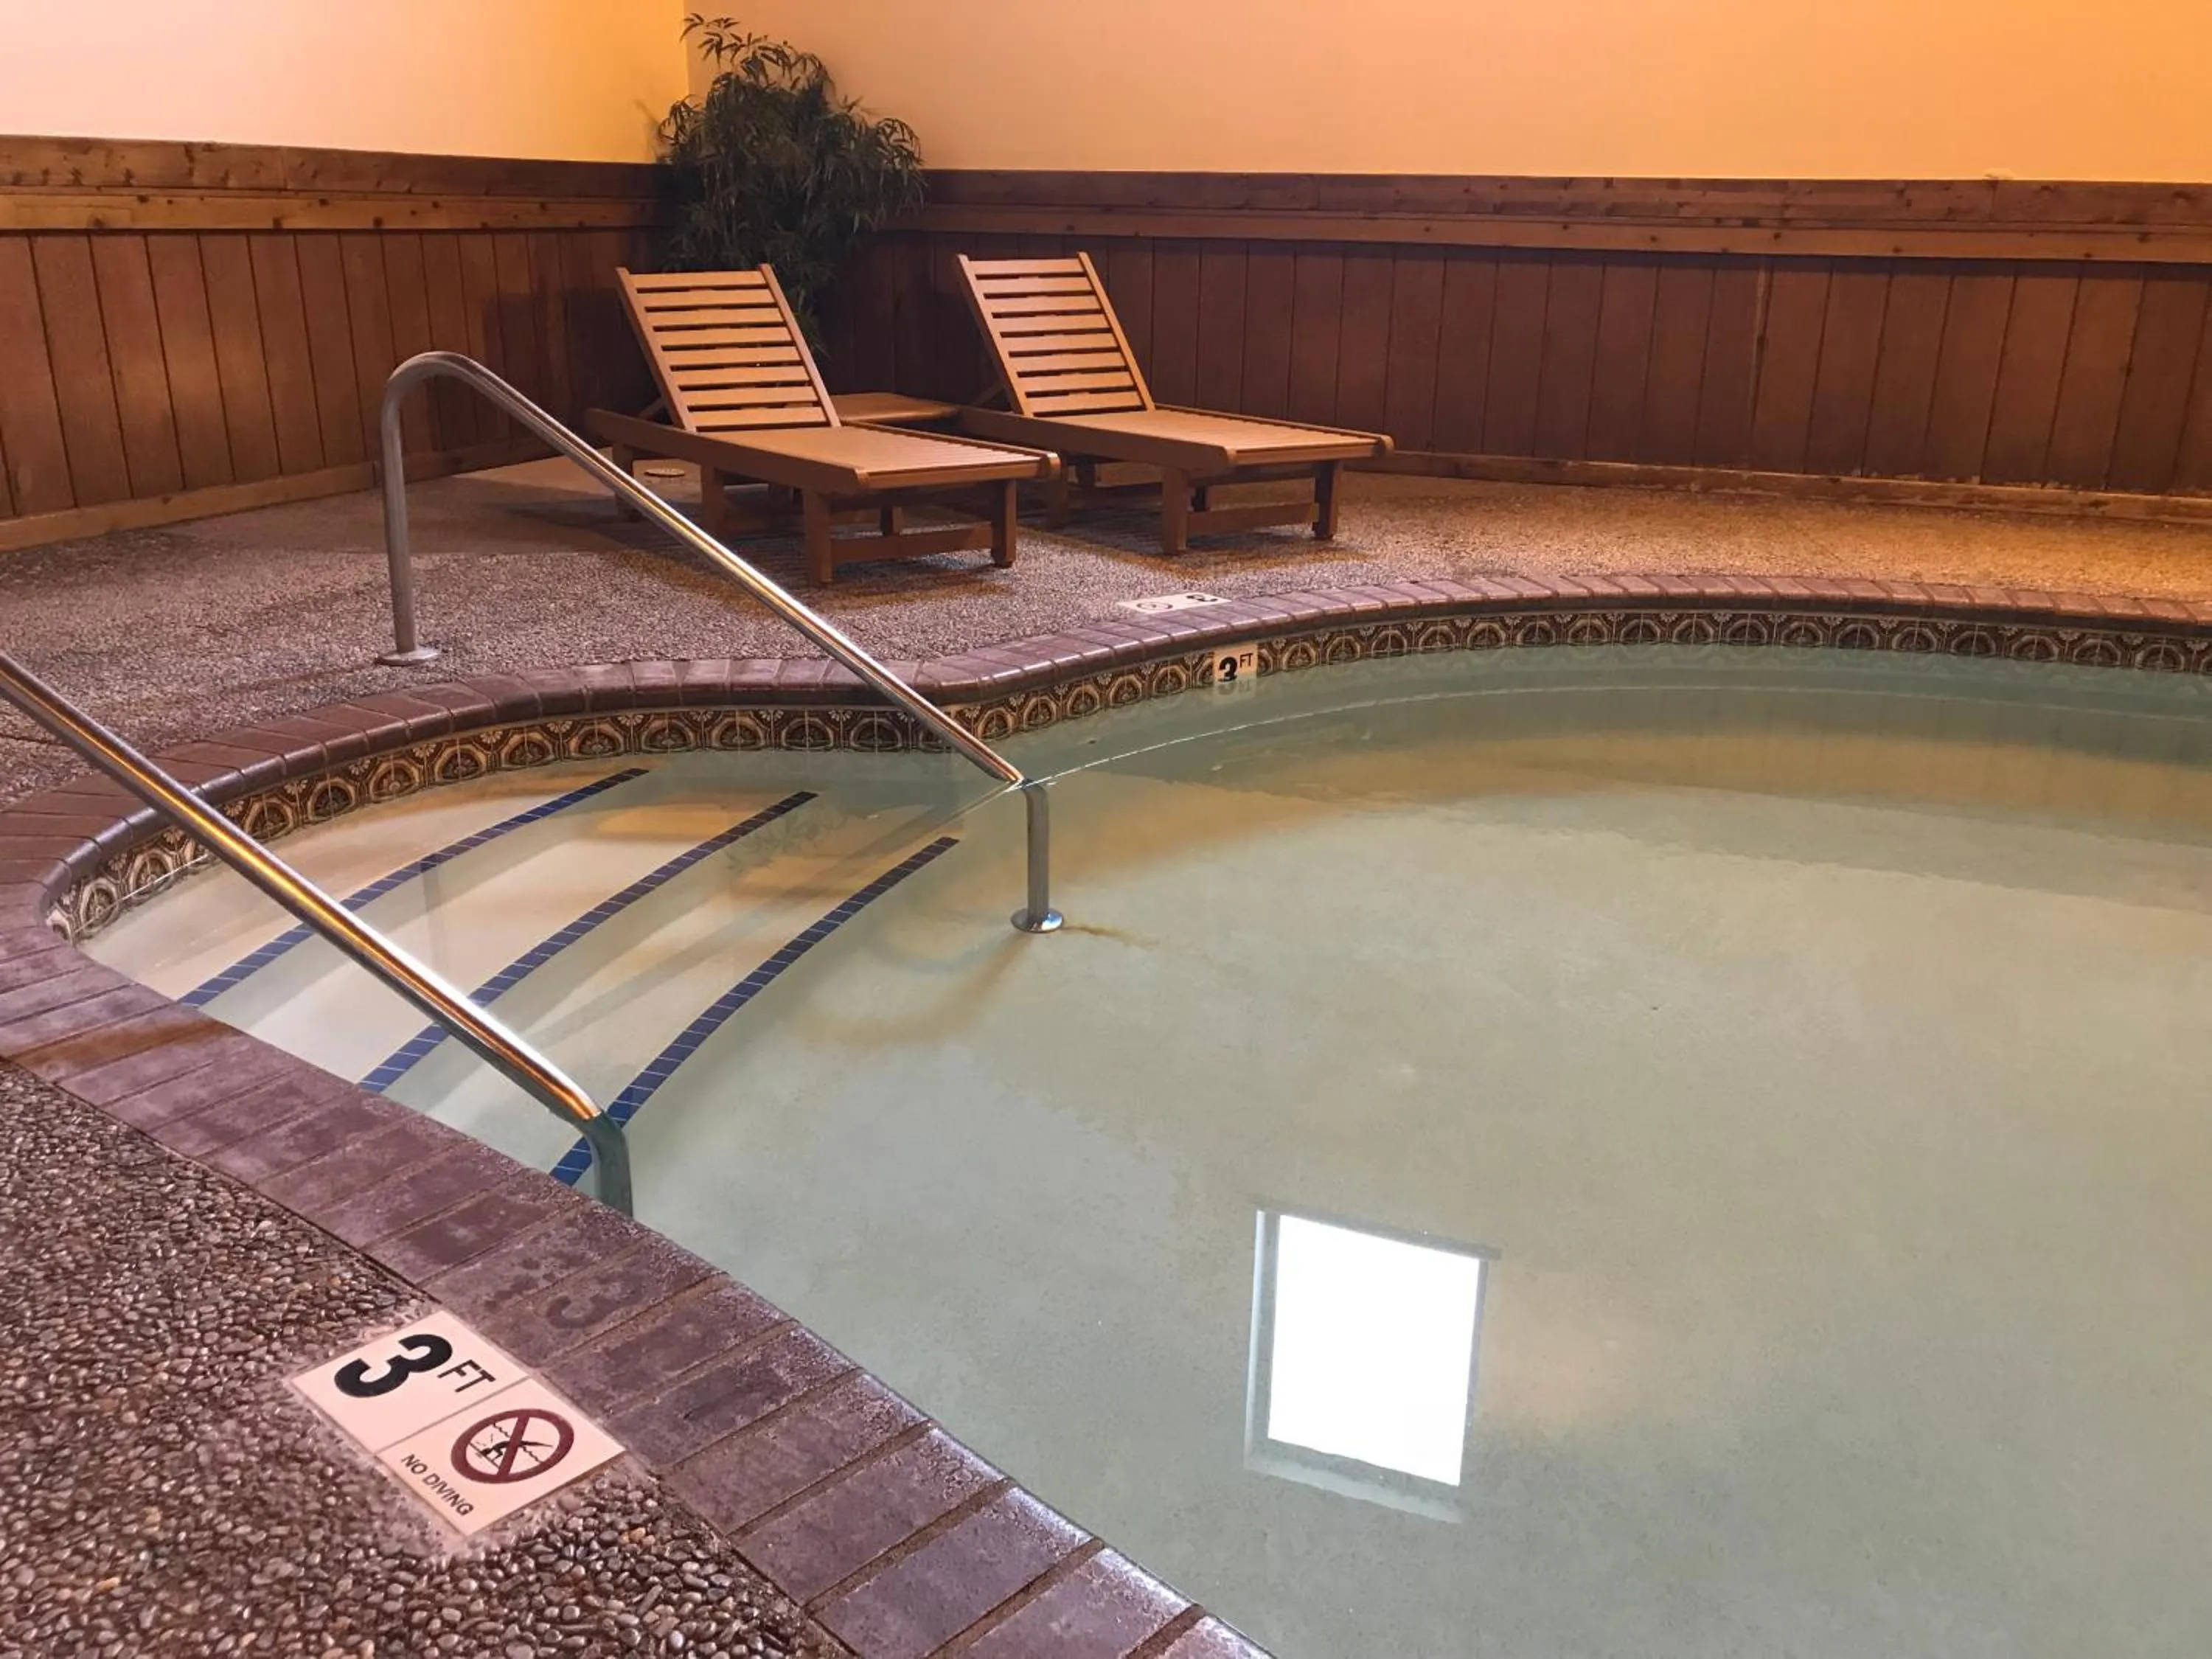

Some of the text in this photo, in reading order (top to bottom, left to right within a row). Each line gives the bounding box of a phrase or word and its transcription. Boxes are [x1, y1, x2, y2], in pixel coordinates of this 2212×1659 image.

[1239, 653, 1254, 668] FT
[334, 1334, 496, 1398] 3 FT
[400, 1454, 474, 1516] NO DIVING
